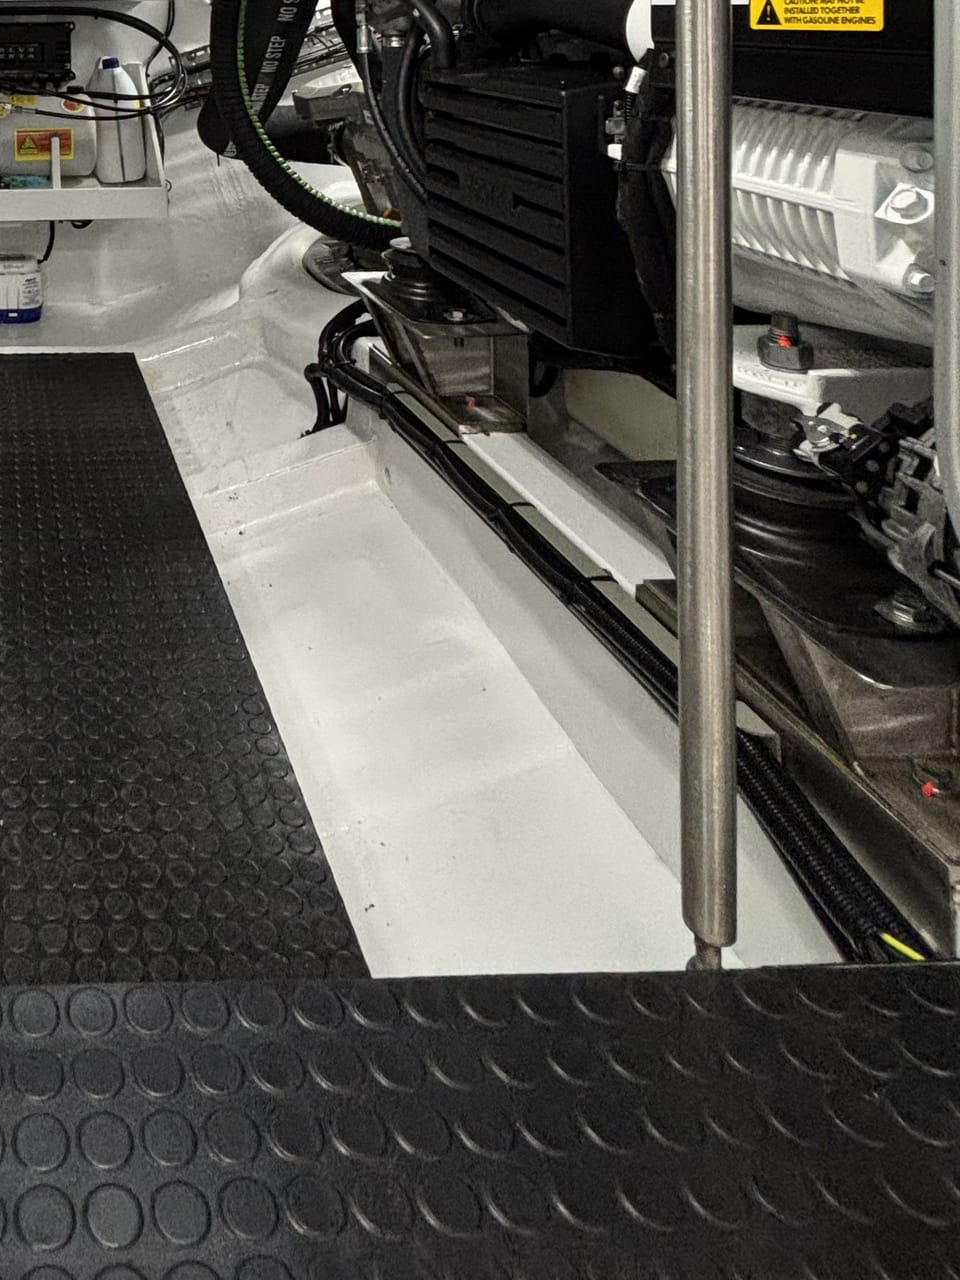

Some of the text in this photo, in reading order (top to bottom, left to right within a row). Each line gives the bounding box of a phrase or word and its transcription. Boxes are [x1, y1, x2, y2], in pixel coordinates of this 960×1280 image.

[276, 6, 297, 22] NO
[784, 6, 860, 15] INSTALLED TOGETHER
[784, 16, 877, 25] WITH GASOLINE ENGINES
[260, 35, 286, 73] NO STEP
